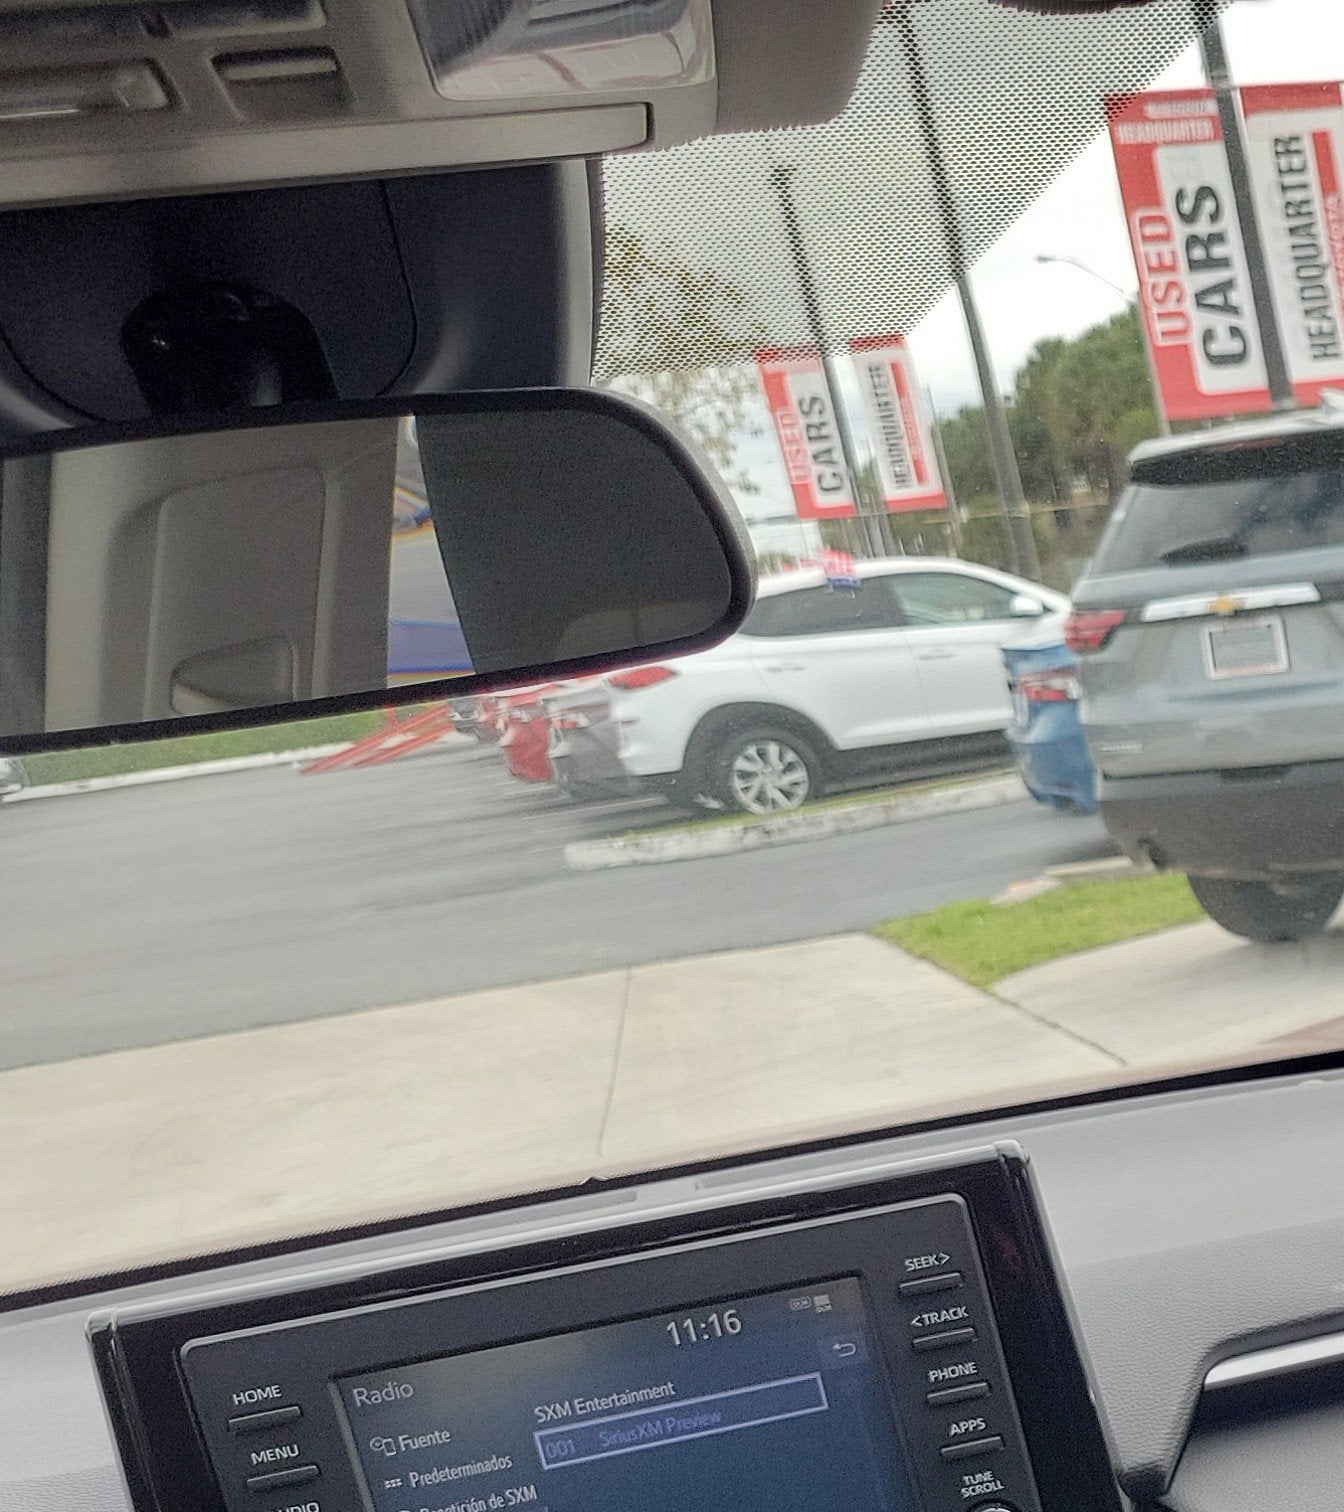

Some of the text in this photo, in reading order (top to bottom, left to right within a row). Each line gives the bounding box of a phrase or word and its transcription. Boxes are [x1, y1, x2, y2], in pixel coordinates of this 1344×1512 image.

[1273, 135, 1341, 360] HEADQUARTER
[1139, 214, 1190, 341] USED
[1175, 185, 1247, 366] CARS
[799, 396, 843, 492] CARS
[666, 1309, 742, 1346] 11:16
[928, 1361, 978, 1383] PHONE
[232, 1385, 282, 1406] HOME
[353, 1382, 414, 1407] Radio
[533, 1381, 676, 1424] SXM Entertainment
[950, 1418, 986, 1436] APPS
[399, 1430, 451, 1453] Fuente
[250, 1444, 300, 1466] MENU
[409, 1455, 513, 1488] Predeterminados
[962, 1471, 995, 1487] TUNE
[489, 1493, 505, 1510] de
[505, 1484, 538, 1507] SXM
[961, 1481, 1004, 1499] SCROLL
